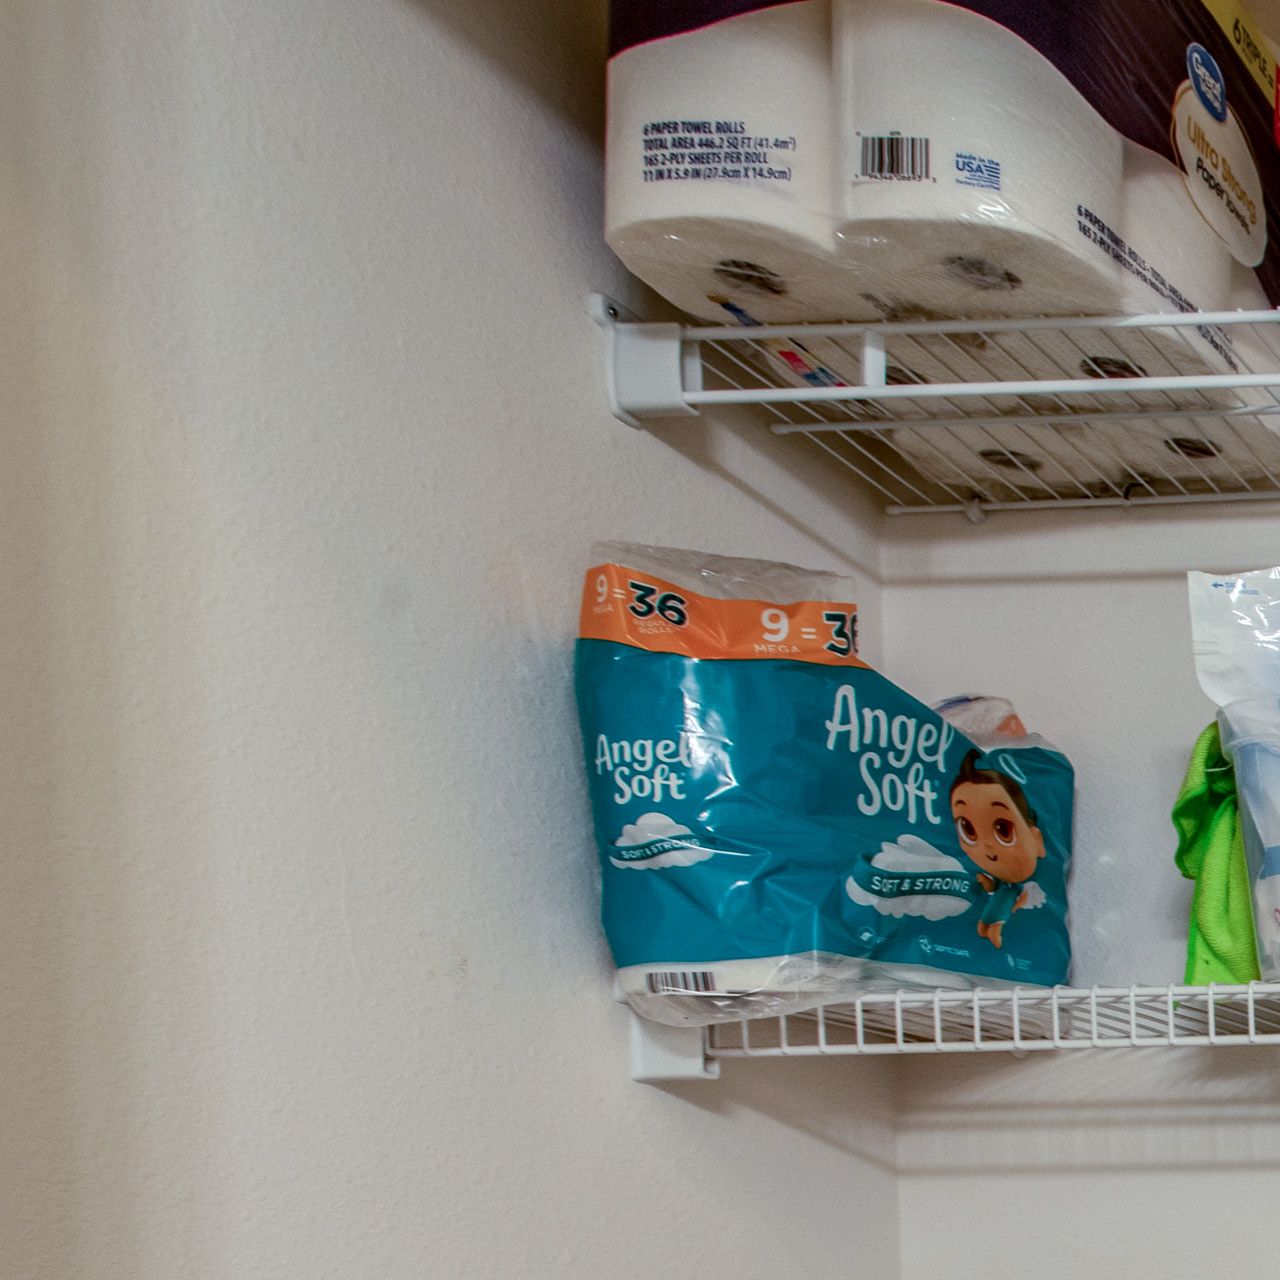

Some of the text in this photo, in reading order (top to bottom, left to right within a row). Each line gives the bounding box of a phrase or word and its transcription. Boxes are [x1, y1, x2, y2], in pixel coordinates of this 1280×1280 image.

[651, 122, 679, 135] PAPER
[681, 121, 713, 134] TOWEL
[715, 121, 746, 135] ROLLS
[643, 138, 668, 151] TOTAL
[671, 137, 695, 149] AREA
[698, 137, 724, 150] 446.2
[726, 136, 739, 150] SQ
[741, 136, 752, 149] FT
[1187, 116, 1219, 171] Ultra
[643, 151, 768, 166] 165 2-PLY SHEETS PER ROLL
[956, 152, 977, 161] Made
[988, 158, 1000, 166] the
[956, 160, 985, 175] USA
[643, 169, 653, 182] 11
[655, 168, 665, 181] IN
[674, 168, 689, 180] 5.9
[691, 167, 704, 180] IN
[752, 167, 792, 182] 14.9cm)
[1196, 157, 1223, 199] Paper
[1077, 204, 1083, 216] 6
[1084, 208, 1106, 234] PAPER
[1077, 220, 1091, 239] 165
[596, 574, 689, 626] 9 36
[761, 608, 790, 642] 9
[754, 643, 800, 655] MEGA
[825, 684, 955, 773] Angel
[595, 734, 693, 775] Angel
[614, 764, 687, 805] Soft
[857, 751, 942, 825] Soft
[871, 875, 971, 894] SOFT & STRONG
